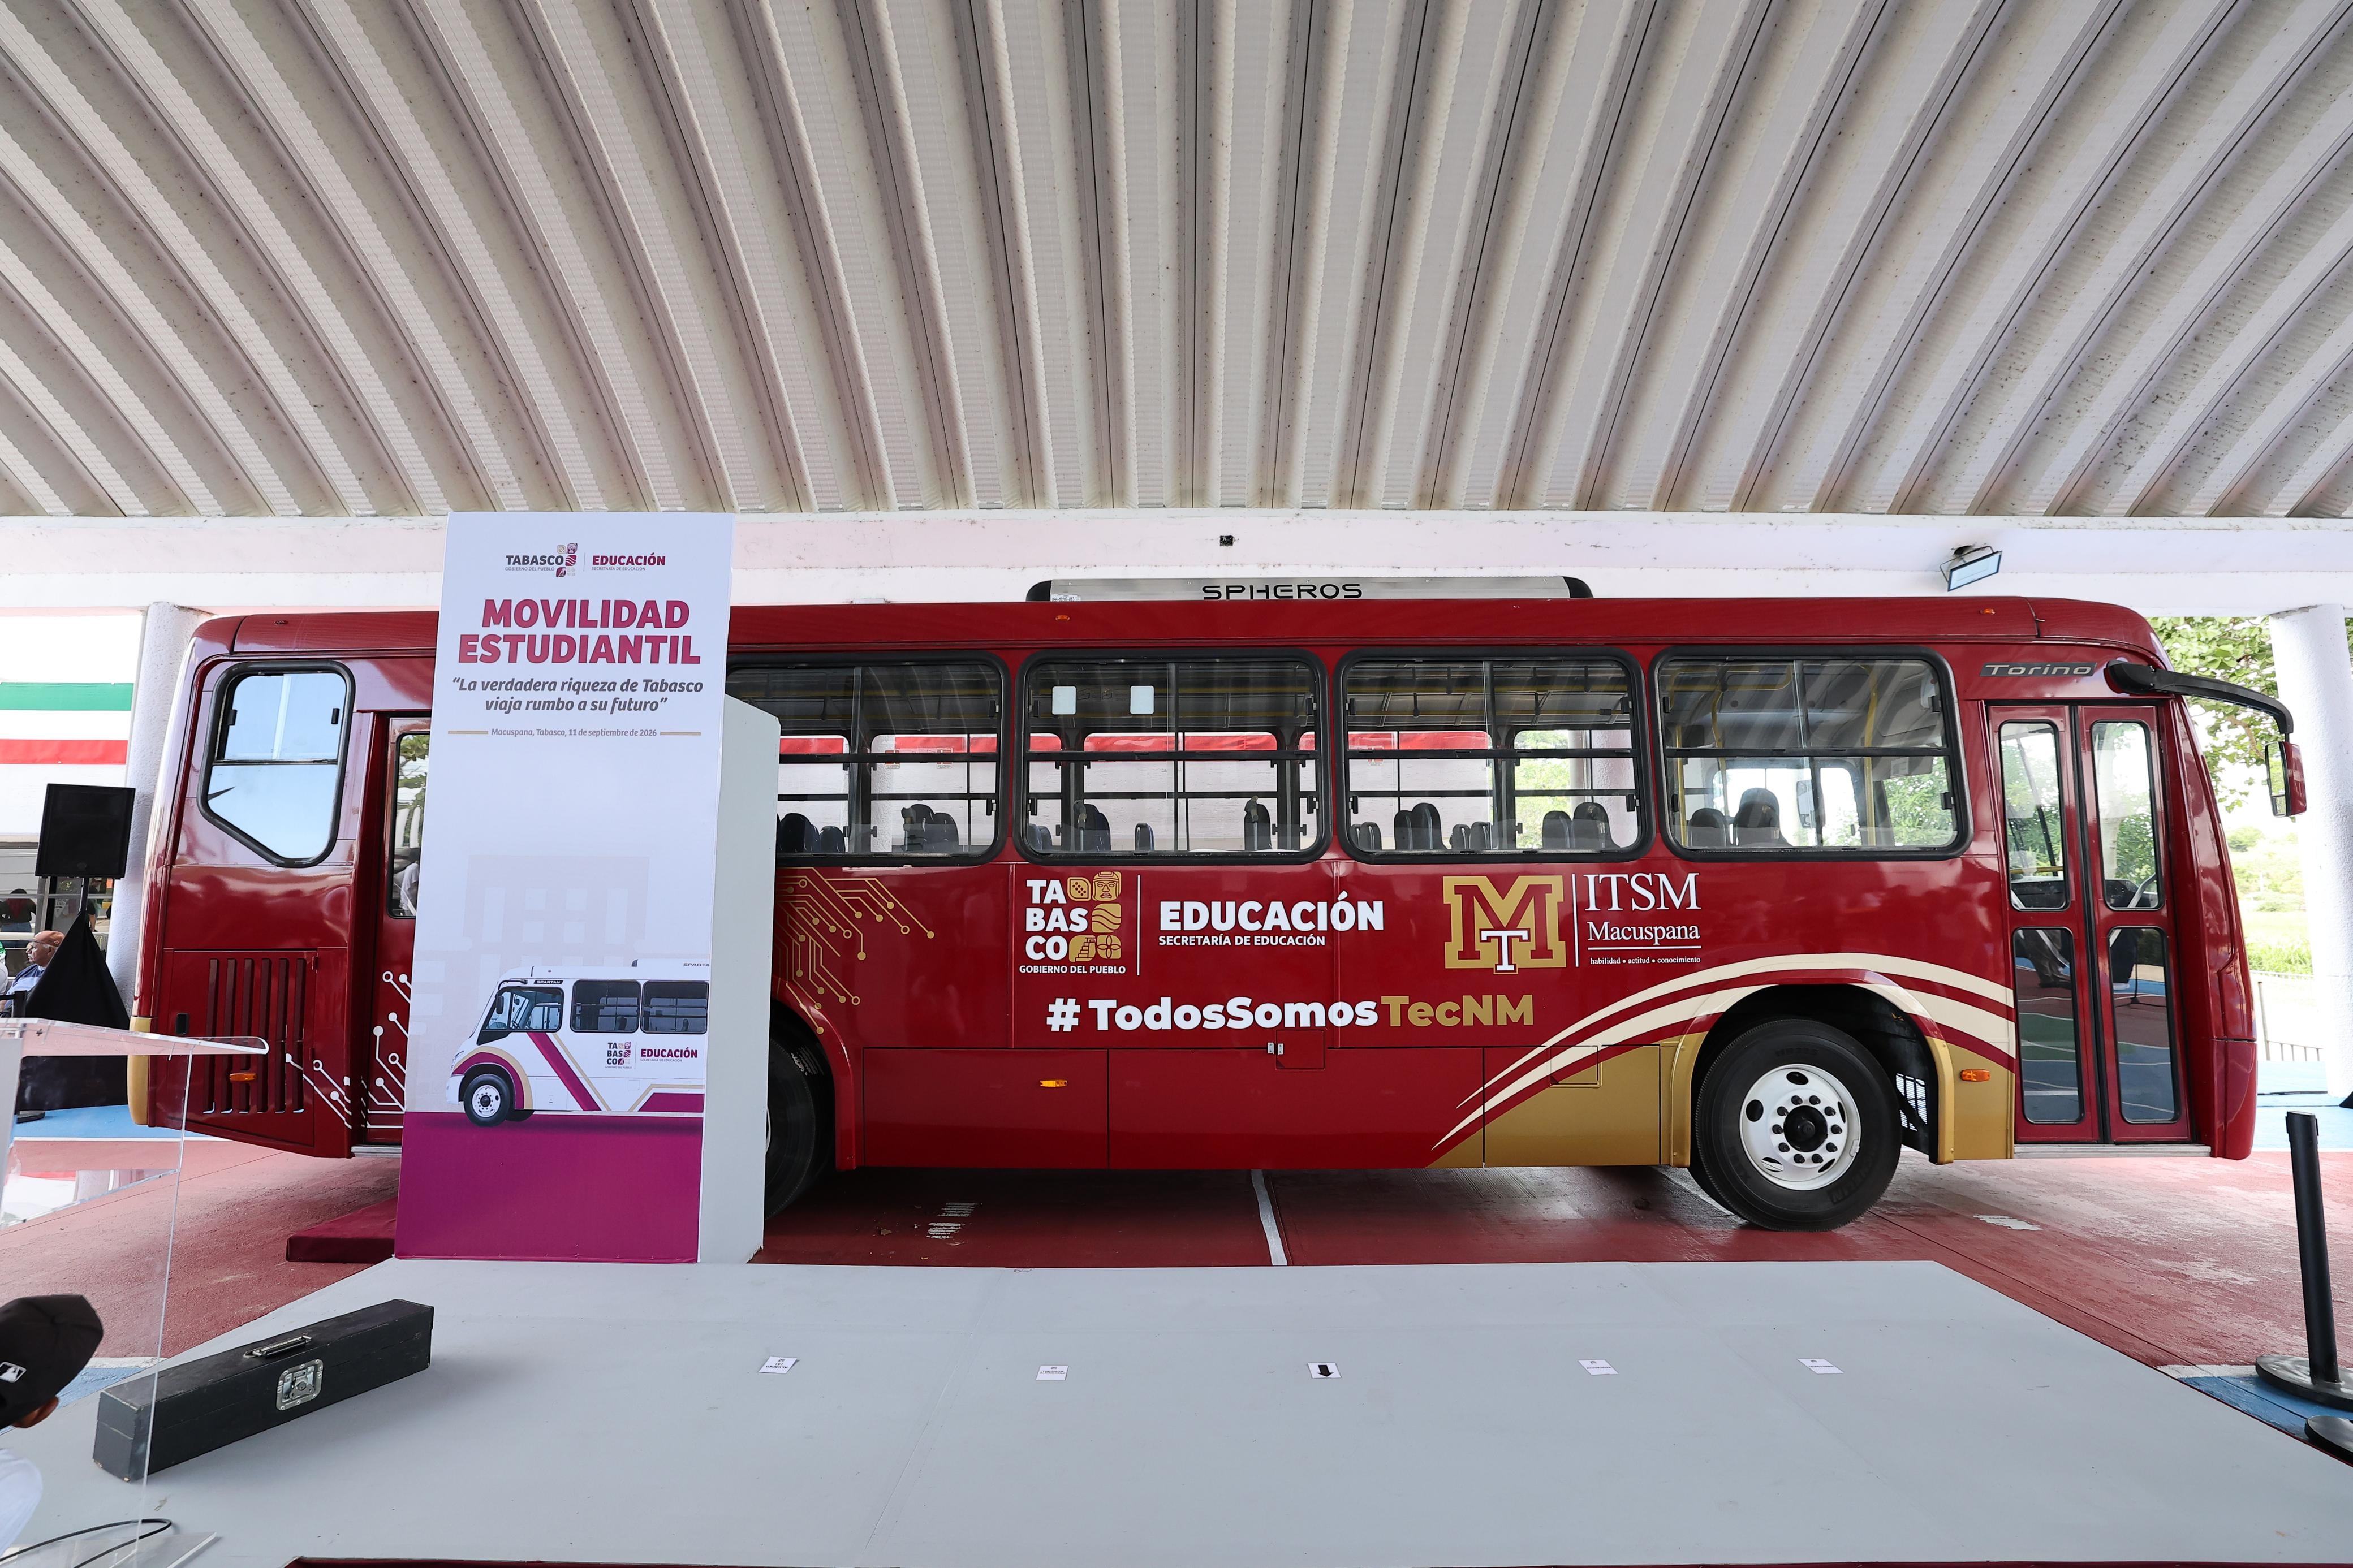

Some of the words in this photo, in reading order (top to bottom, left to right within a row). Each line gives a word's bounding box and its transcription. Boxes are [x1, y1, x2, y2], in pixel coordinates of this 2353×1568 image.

[506, 555, 564, 565] TABASCO
[592, 552, 666, 566] EDUCACIÓN
[1202, 583, 1363, 600] SPHEROS
[481, 598, 690, 629] MOVILIDAD
[458, 634, 701, 664] ESTUDIANTIL
[1985, 664, 2091, 675] Torino
[453, 677, 477, 692] “La
[481, 677, 557, 692] verdadera
[560, 678, 617, 696] riqueza
[620, 678, 639, 692] de
[643, 679, 704, 693] Tabasco
[485, 696, 522, 715] viaja
[525, 697, 575, 711] rumbo
[577, 700, 587, 711] a
[590, 700, 607, 711] su
[610, 697, 667, 715] futuro”
[491, 728, 535, 737] Macuspana,
[536, 728, 567, 737] Tabasco,
[588, 728, 628, 738] septiembre
[1026, 879, 1067, 904] TA
[1583, 872, 1701, 911] ITSM
[1025, 908, 1088, 932] BAS
[1160, 890, 1384, 931] EDUCACIÓN
[1158, 933, 1231, 946] SECRETARÍA
[1235, 936, 1251, 945] DE
[1254, 934, 1325, 946] EDUCACIÓN
[1587, 921, 1701, 945] Macuspana
[1025, 935, 1070, 960] CO
[1019, 965, 1068, 974] GOBIERNO
[1070, 965, 1088, 974] DEL
[640, 1047, 698, 1058] EDUCACIÓN
